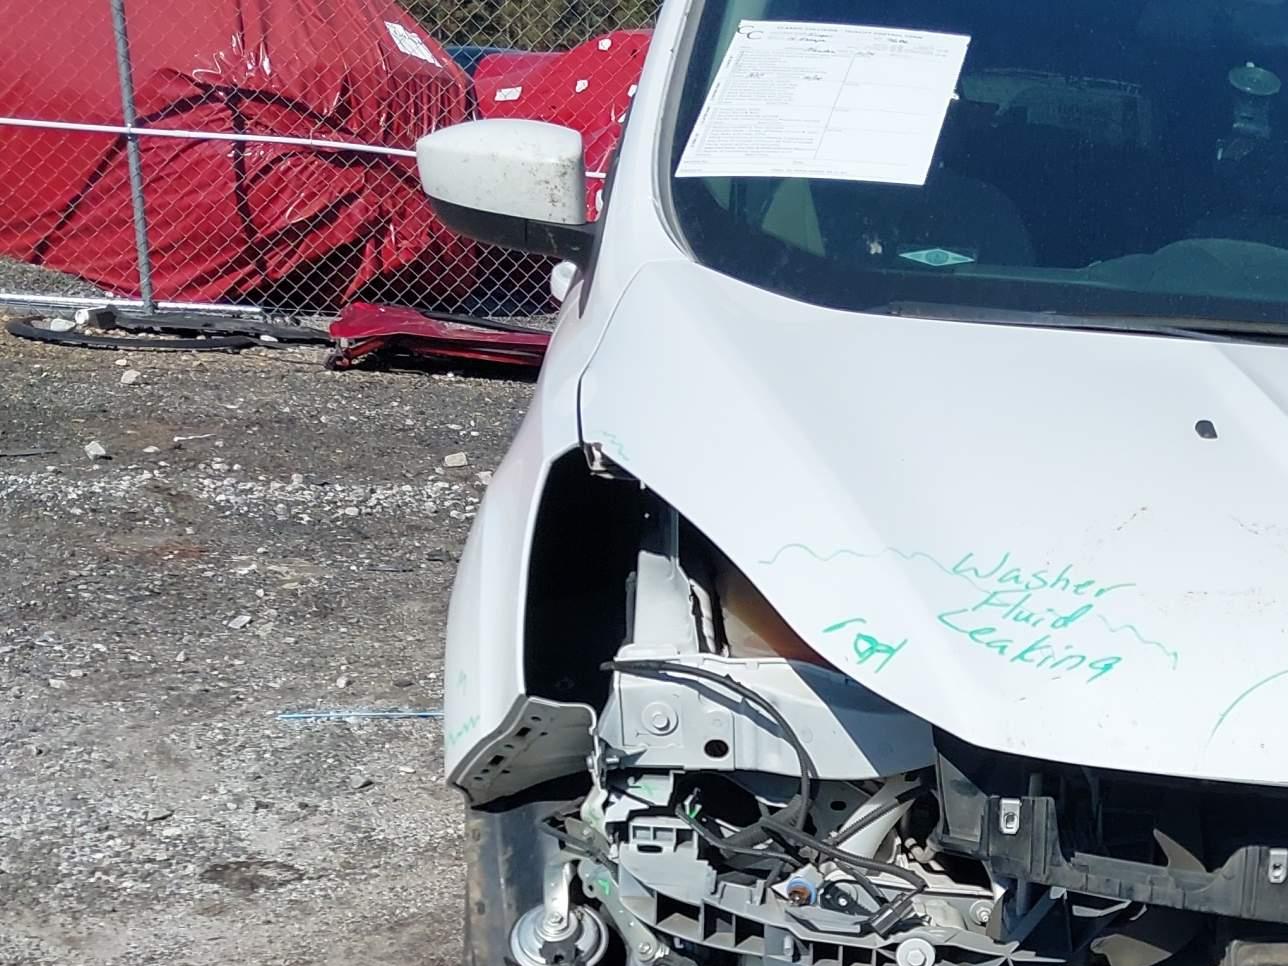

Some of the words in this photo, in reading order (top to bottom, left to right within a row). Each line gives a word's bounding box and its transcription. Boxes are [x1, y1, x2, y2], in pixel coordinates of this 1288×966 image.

[952, 552, 1137, 600] Washer
[971, 589, 1093, 630] Fluid
[936, 608, 1123, 682] Leaking
